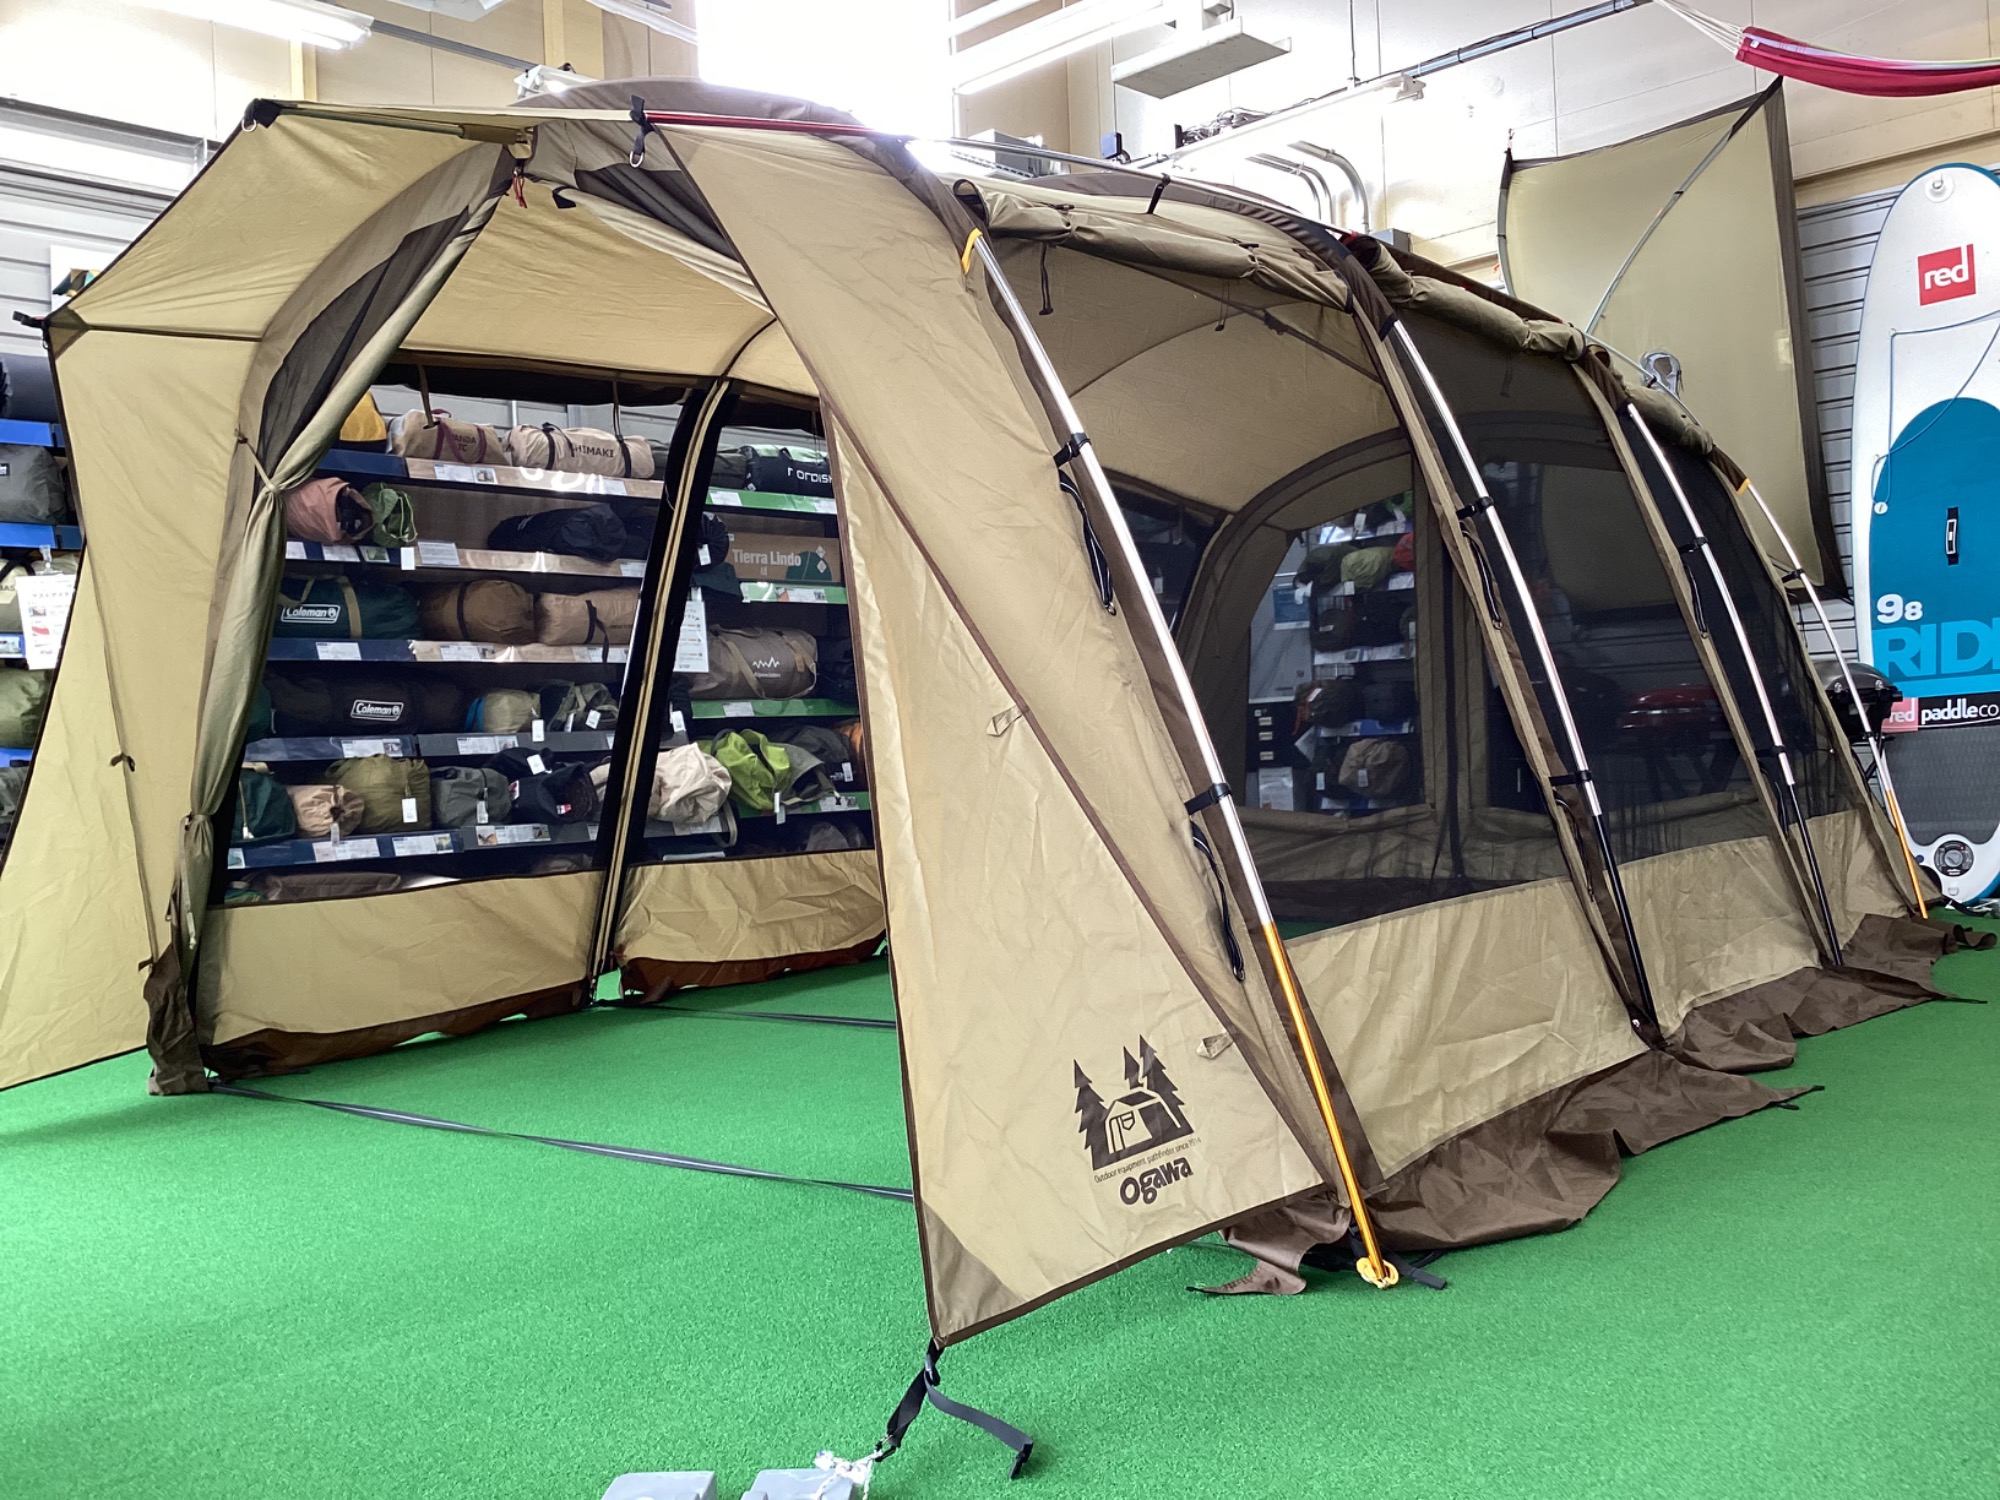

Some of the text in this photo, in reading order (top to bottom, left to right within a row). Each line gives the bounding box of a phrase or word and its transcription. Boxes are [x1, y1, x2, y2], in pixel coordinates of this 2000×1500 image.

[1925, 245, 1969, 290] red
[454, 434, 477, 444] ANDA
[732, 549, 801, 567] Tierra Lindo
[286, 606, 327, 617] Coleman
[356, 703, 392, 715] Coleman
[1889, 698, 1915, 723] red
[1094, 1169, 1117, 1183] Outdoor
[1117, 1157, 1146, 1175] equipment
[1146, 1146, 1175, 1164] pathfinder
[1175, 1142, 1190, 1153] since
